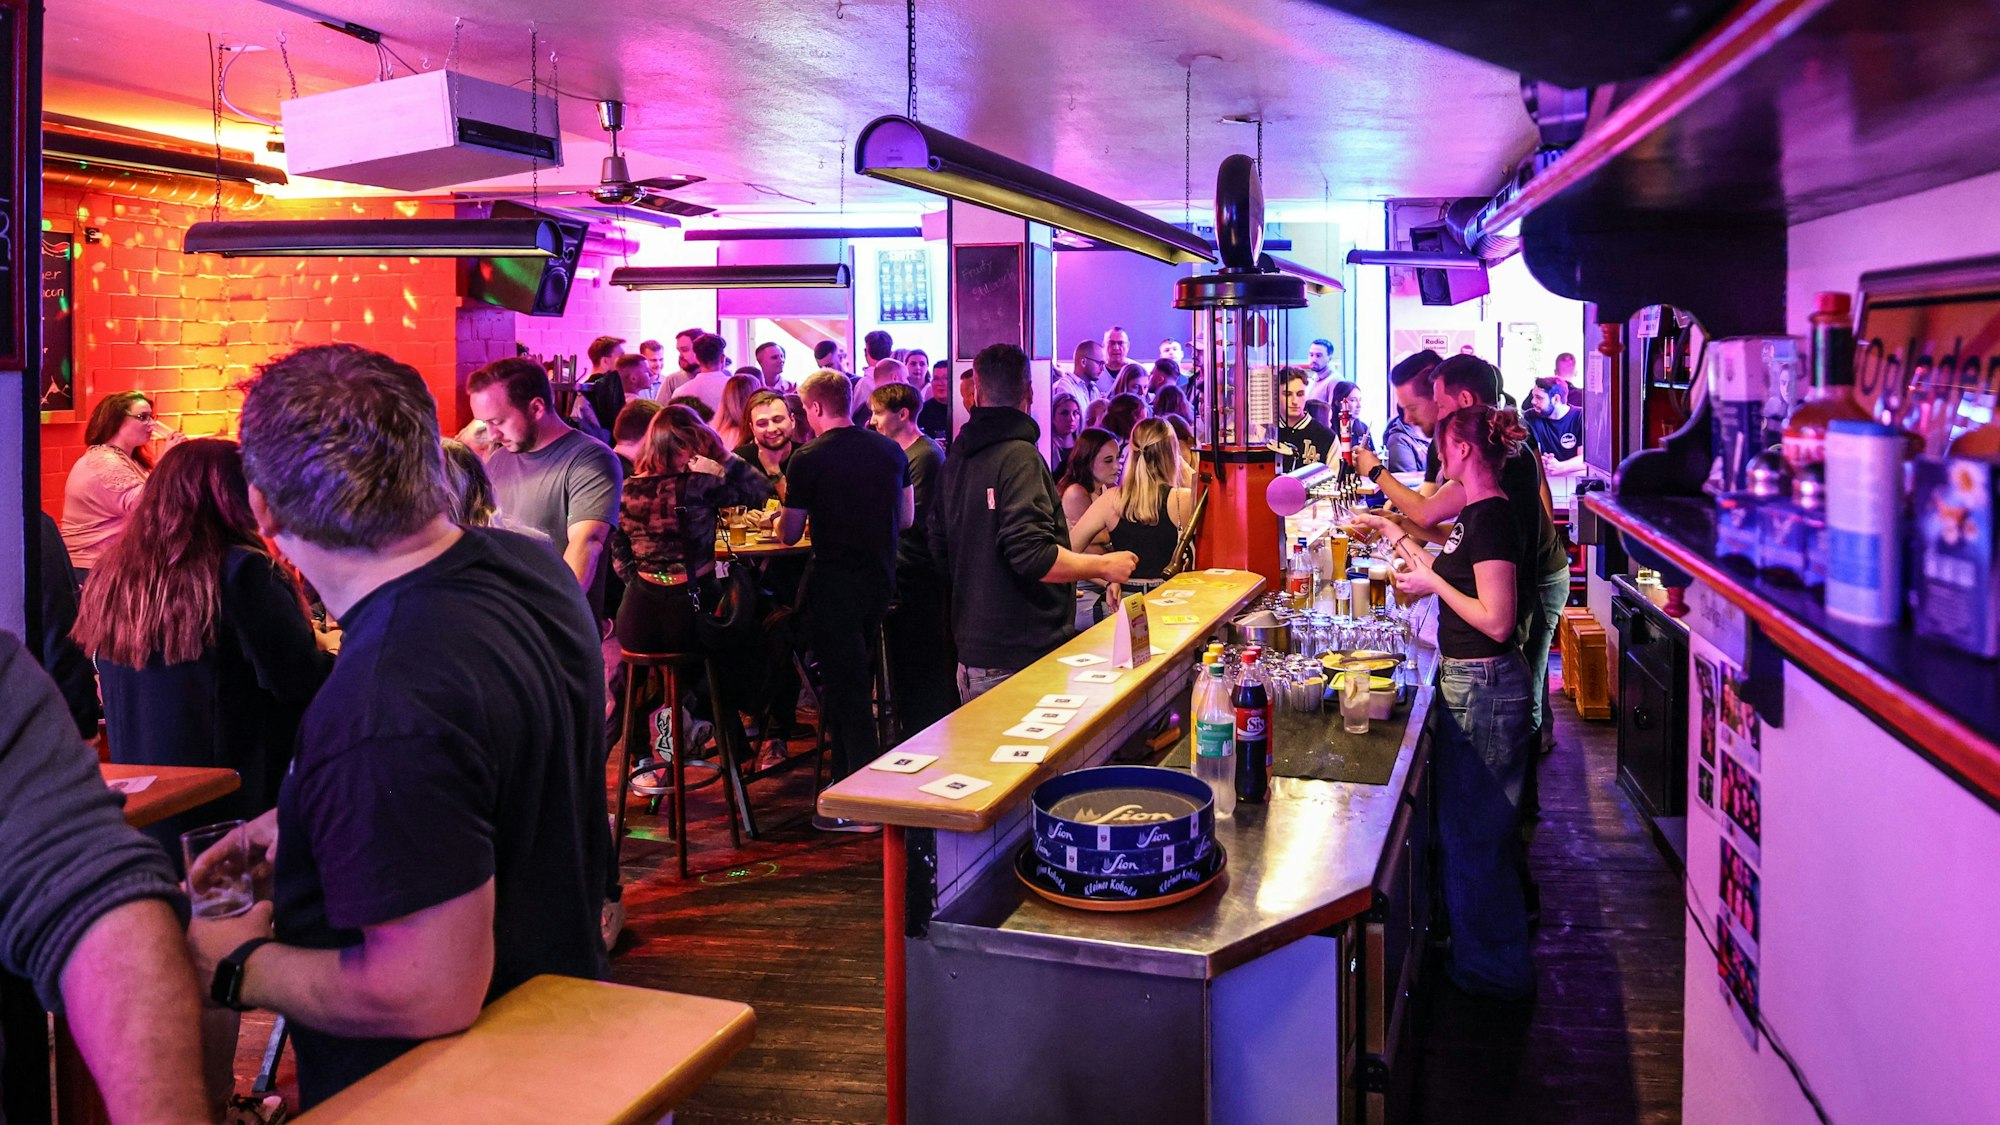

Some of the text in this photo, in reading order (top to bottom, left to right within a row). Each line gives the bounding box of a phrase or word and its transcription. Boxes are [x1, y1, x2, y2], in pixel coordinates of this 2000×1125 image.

[961, 259, 993, 280] Fruity
[1302, 438, 1321, 465] LA
[1249, 717, 1264, 730] Sis
[1087, 804, 1174, 823] Sion
[1048, 821, 1074, 842] Sion
[1136, 826, 1171, 848] Sion
[1101, 853, 1139, 874] Sion
[1084, 878, 1138, 896] Kleiner Kobold
